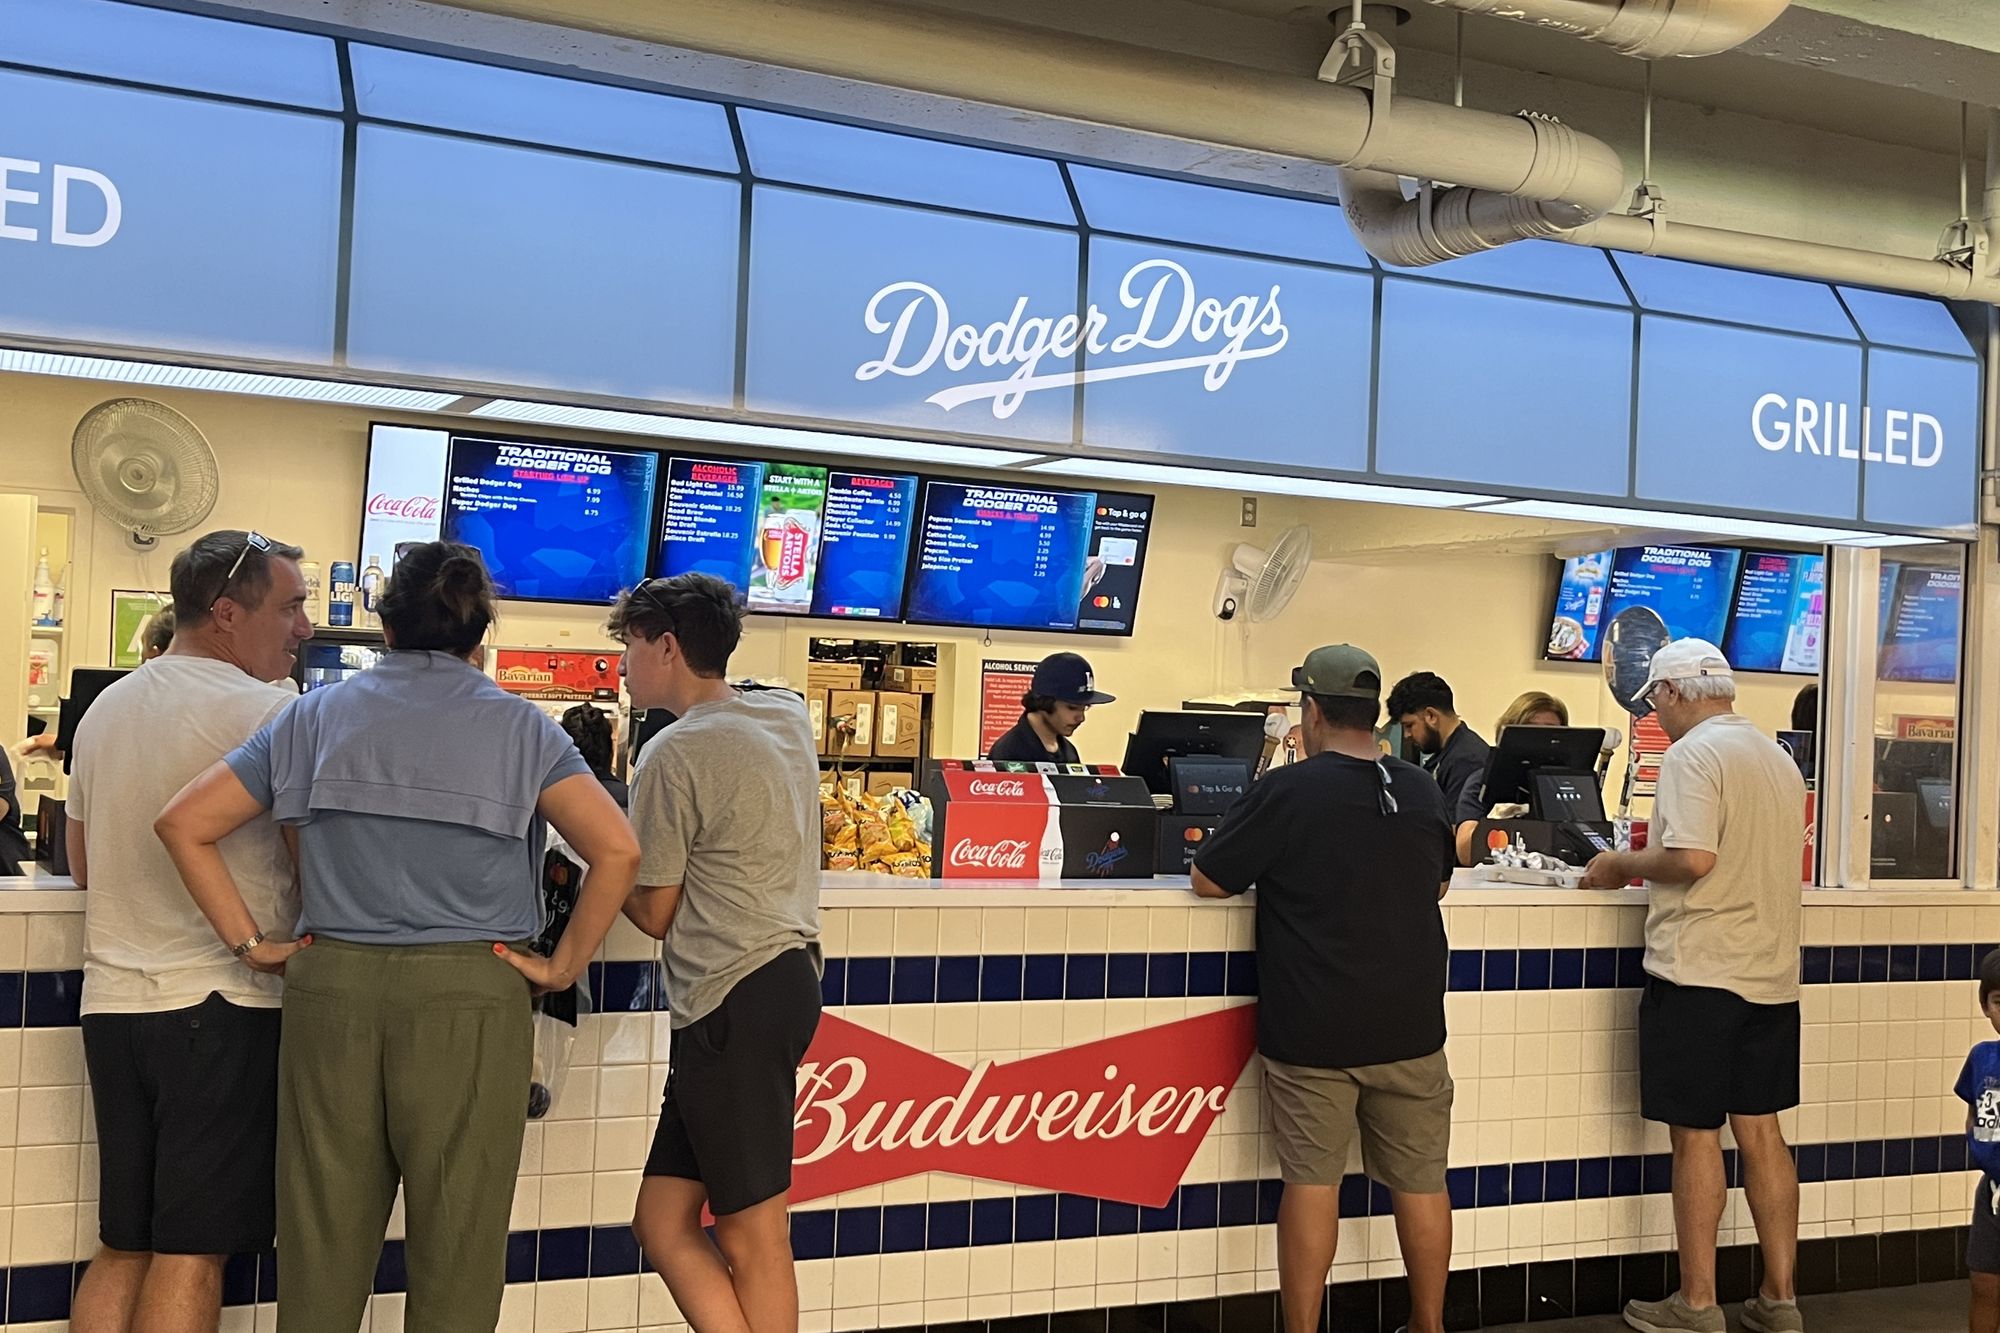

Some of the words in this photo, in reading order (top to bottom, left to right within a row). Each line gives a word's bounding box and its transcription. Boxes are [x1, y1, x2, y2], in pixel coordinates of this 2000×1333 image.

[855, 281, 1108, 418] Dodger
[1111, 259, 1288, 391] Dogs
[1752, 393, 1943, 467] GRILLED
[498, 446, 611, 465] TRADITIONAL
[496, 456, 570, 472] DODGER
[573, 463, 612, 475] DOG
[692, 464, 737, 475] ALCOHOLIC
[453, 476, 478, 485] Grilled
[479, 478, 506, 487] Dodger
[507, 481, 522, 490] Dog
[671, 479, 685, 487] Bud
[685, 480, 703, 488] Light
[691, 472, 737, 484] BEVERAGES
[769, 475, 792, 485] START
[793, 477, 813, 487] WITH
[814, 479, 820, 487] A
[851, 477, 894, 488] BEVERAGES
[452, 485, 480, 493] Nachos
[696, 489, 723, 497] Especial
[764, 484, 789, 494] STELLA
[797, 488, 823, 496] ARTOIS
[829, 487, 851, 495] Dunkin
[852, 489, 872, 497] Coffee
[828, 494, 865, 503] Smartwater
[865, 497, 885, 505] Bottle
[965, 489, 1058, 505] TRADITIONAL
[368, 493, 440, 519] Coca-Cola
[451, 498, 474, 506] Super
[474, 500, 501, 509] Dodger
[502, 503, 517, 511] Dog
[669, 500, 698, 509] Souvenir
[699, 503, 723, 511] Golden
[963, 498, 1023, 511] DODGER
[1026, 503, 1058, 514] DOG
[826, 508, 857, 516] Chocolate
[1108, 508, 1122, 518] Tap
[1122, 509, 1128, 517] &
[1129, 511, 1139, 519] go
[826, 515, 846, 523] Player
[846, 517, 874, 525] Collector
[928, 515, 953, 524] Popcorn
[954, 517, 980, 525] Souvenir
[665, 528, 695, 536] Souvenir
[928, 523, 952, 531] Peanuts
[664, 534, 687, 542] Jalisco
[688, 535, 705, 543] Draft
[852, 531, 879, 539] Fountain
[947, 533, 966, 541] Candy
[782, 531, 794, 576] ARTOIS
[789, 532, 804, 576] STELLA
[924, 547, 949, 555] Popcorn
[1643, 547, 1712, 560] TRADITIONAL
[923, 555, 937, 563] King
[1641, 555, 1686, 565] DODGER
[1687, 559, 1712, 567] DOG
[984, 662, 1012, 671] ALCOHOL
[1013, 664, 1038, 672] SERVIC
[498, 670, 551, 682] Bavarian
[969, 779, 1024, 797] Coca-Cola
[1201, 784, 1214, 793] Tap
[1222, 785, 1233, 793] Go
[950, 838, 1031, 869] Coca-Cola
[791, 1057, 1226, 1165] Budweiser
